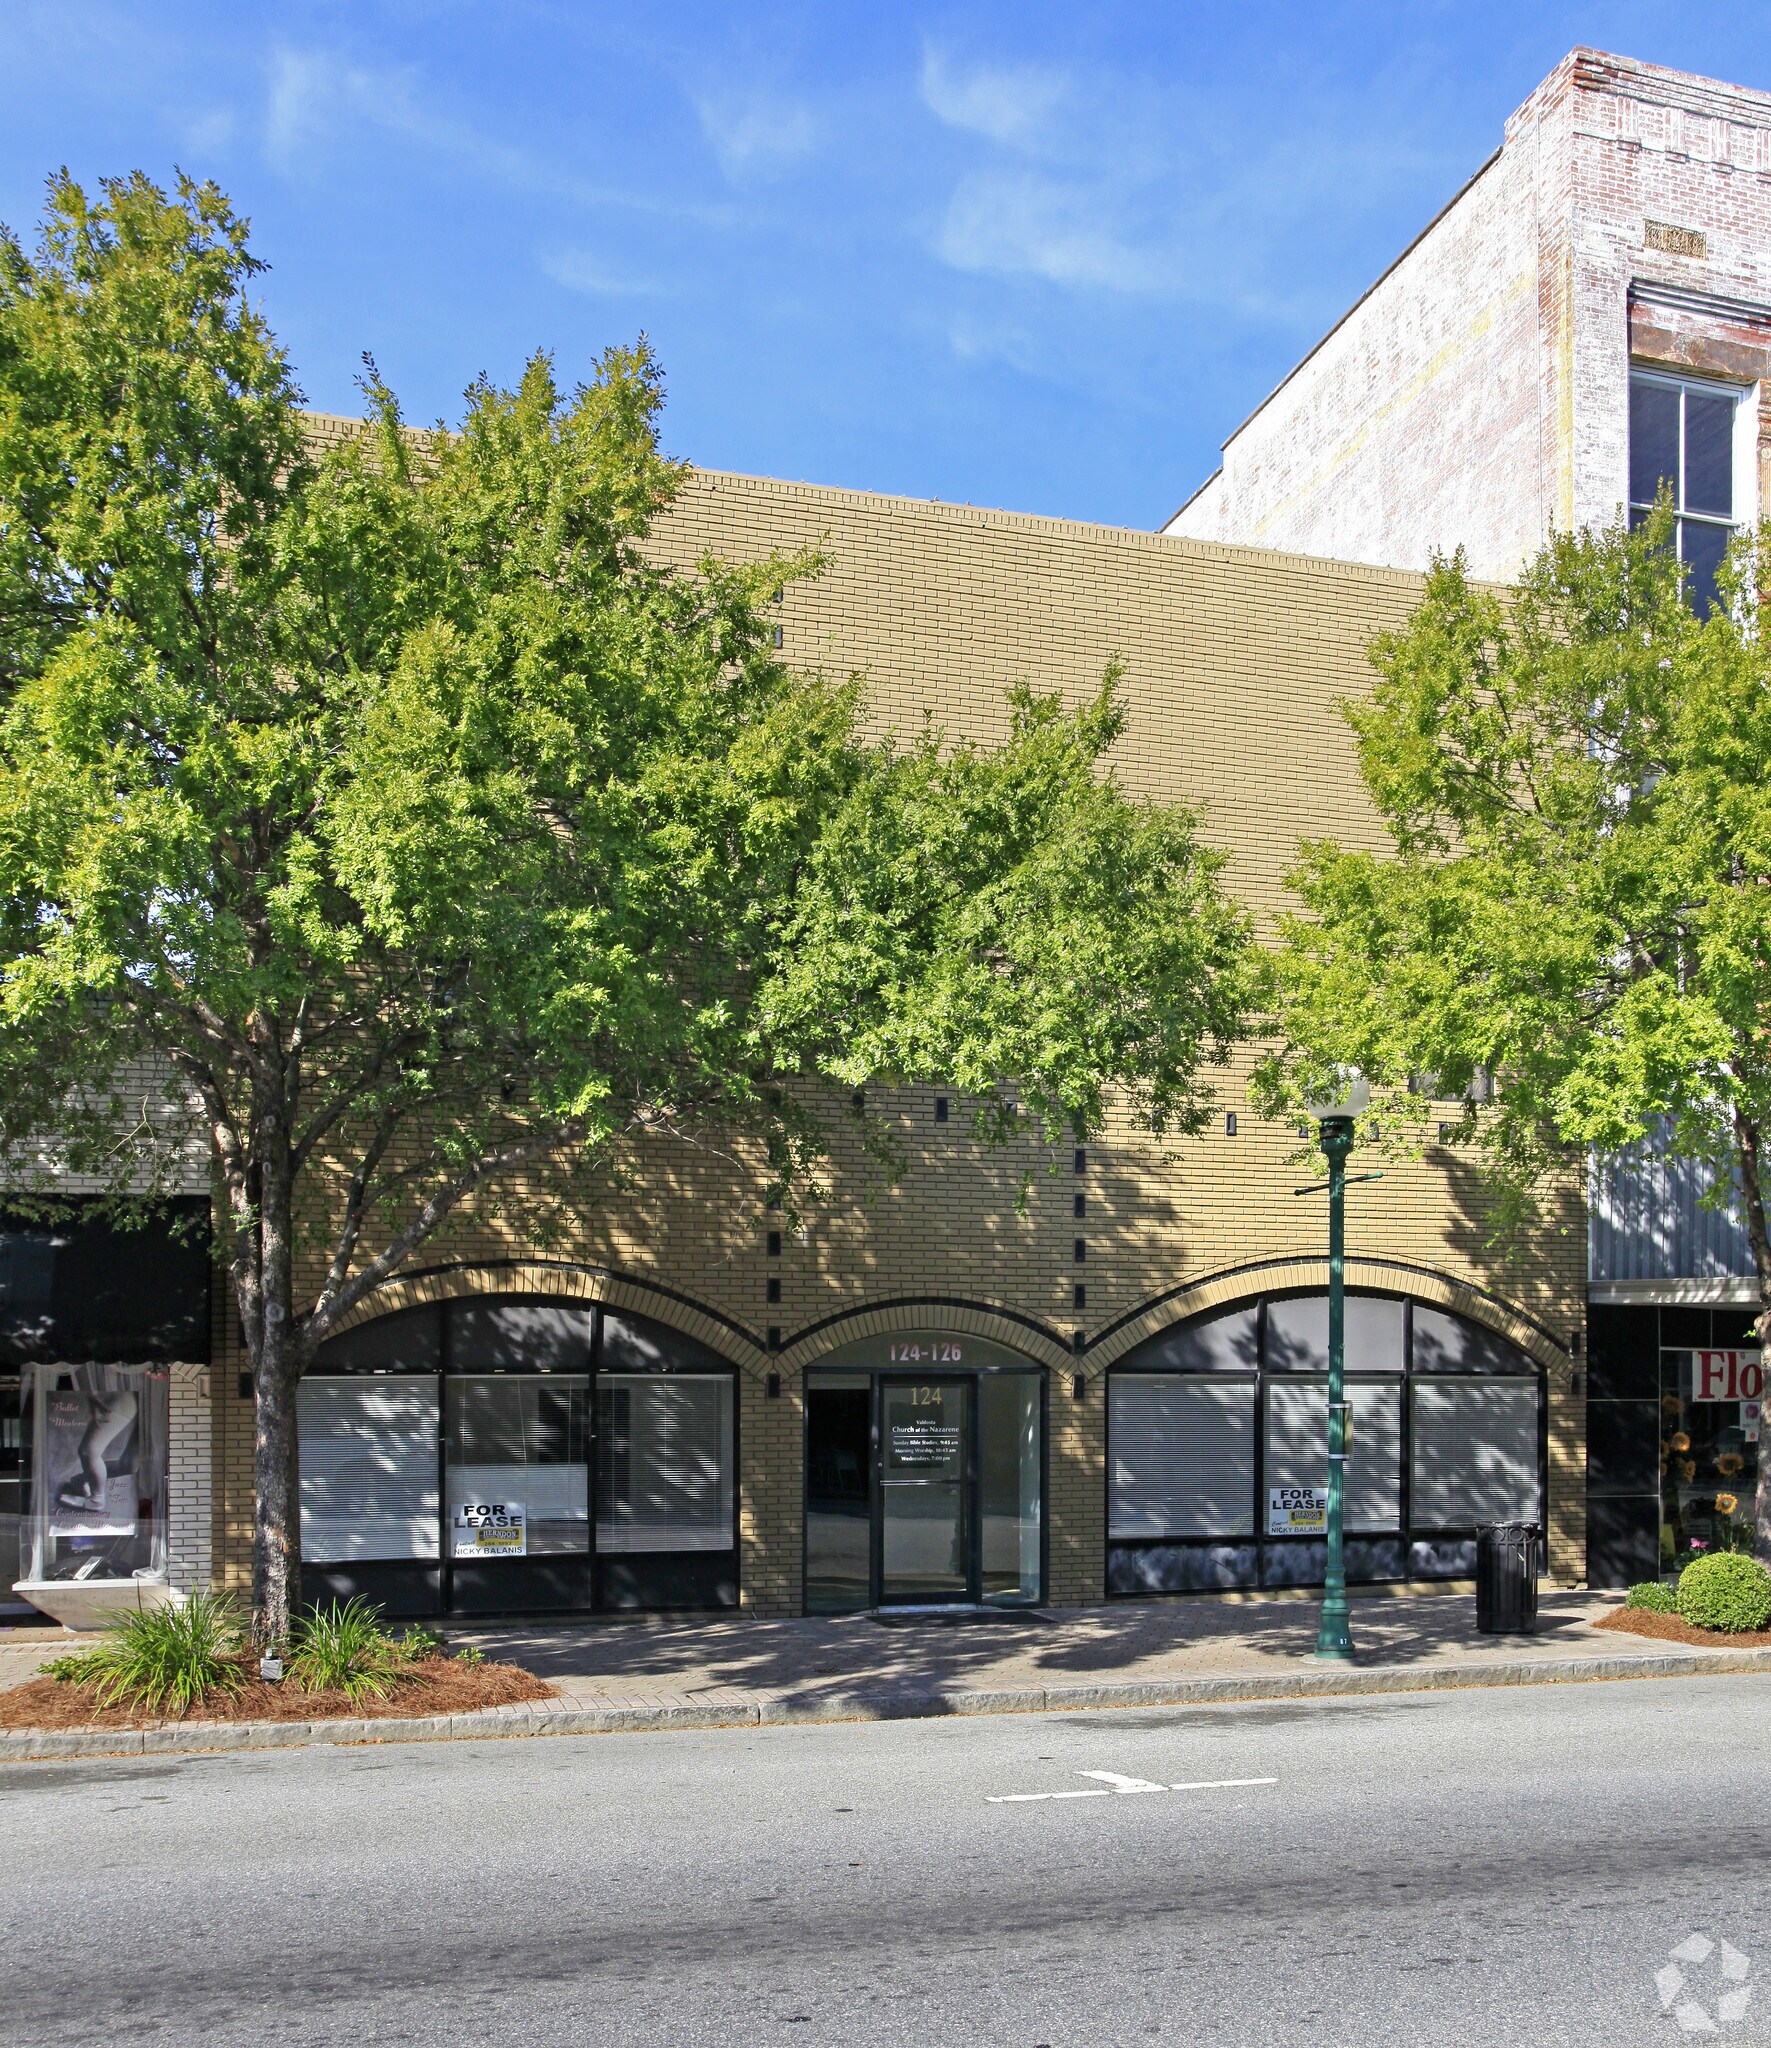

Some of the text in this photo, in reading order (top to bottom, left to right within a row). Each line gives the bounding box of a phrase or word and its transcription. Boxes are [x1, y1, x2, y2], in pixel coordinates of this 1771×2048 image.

[890, 1343, 961, 1361] 124-126
[911, 1386, 942, 1405] 124
[1281, 1489, 1313, 1499] FOR
[1273, 1500, 1326, 1509] LEASE
[464, 1505, 506, 1516] FOR
[454, 1516, 523, 1528] LEASE
[483, 1529, 517, 1538] HERNDON
[454, 1547, 481, 1555] NICKY
